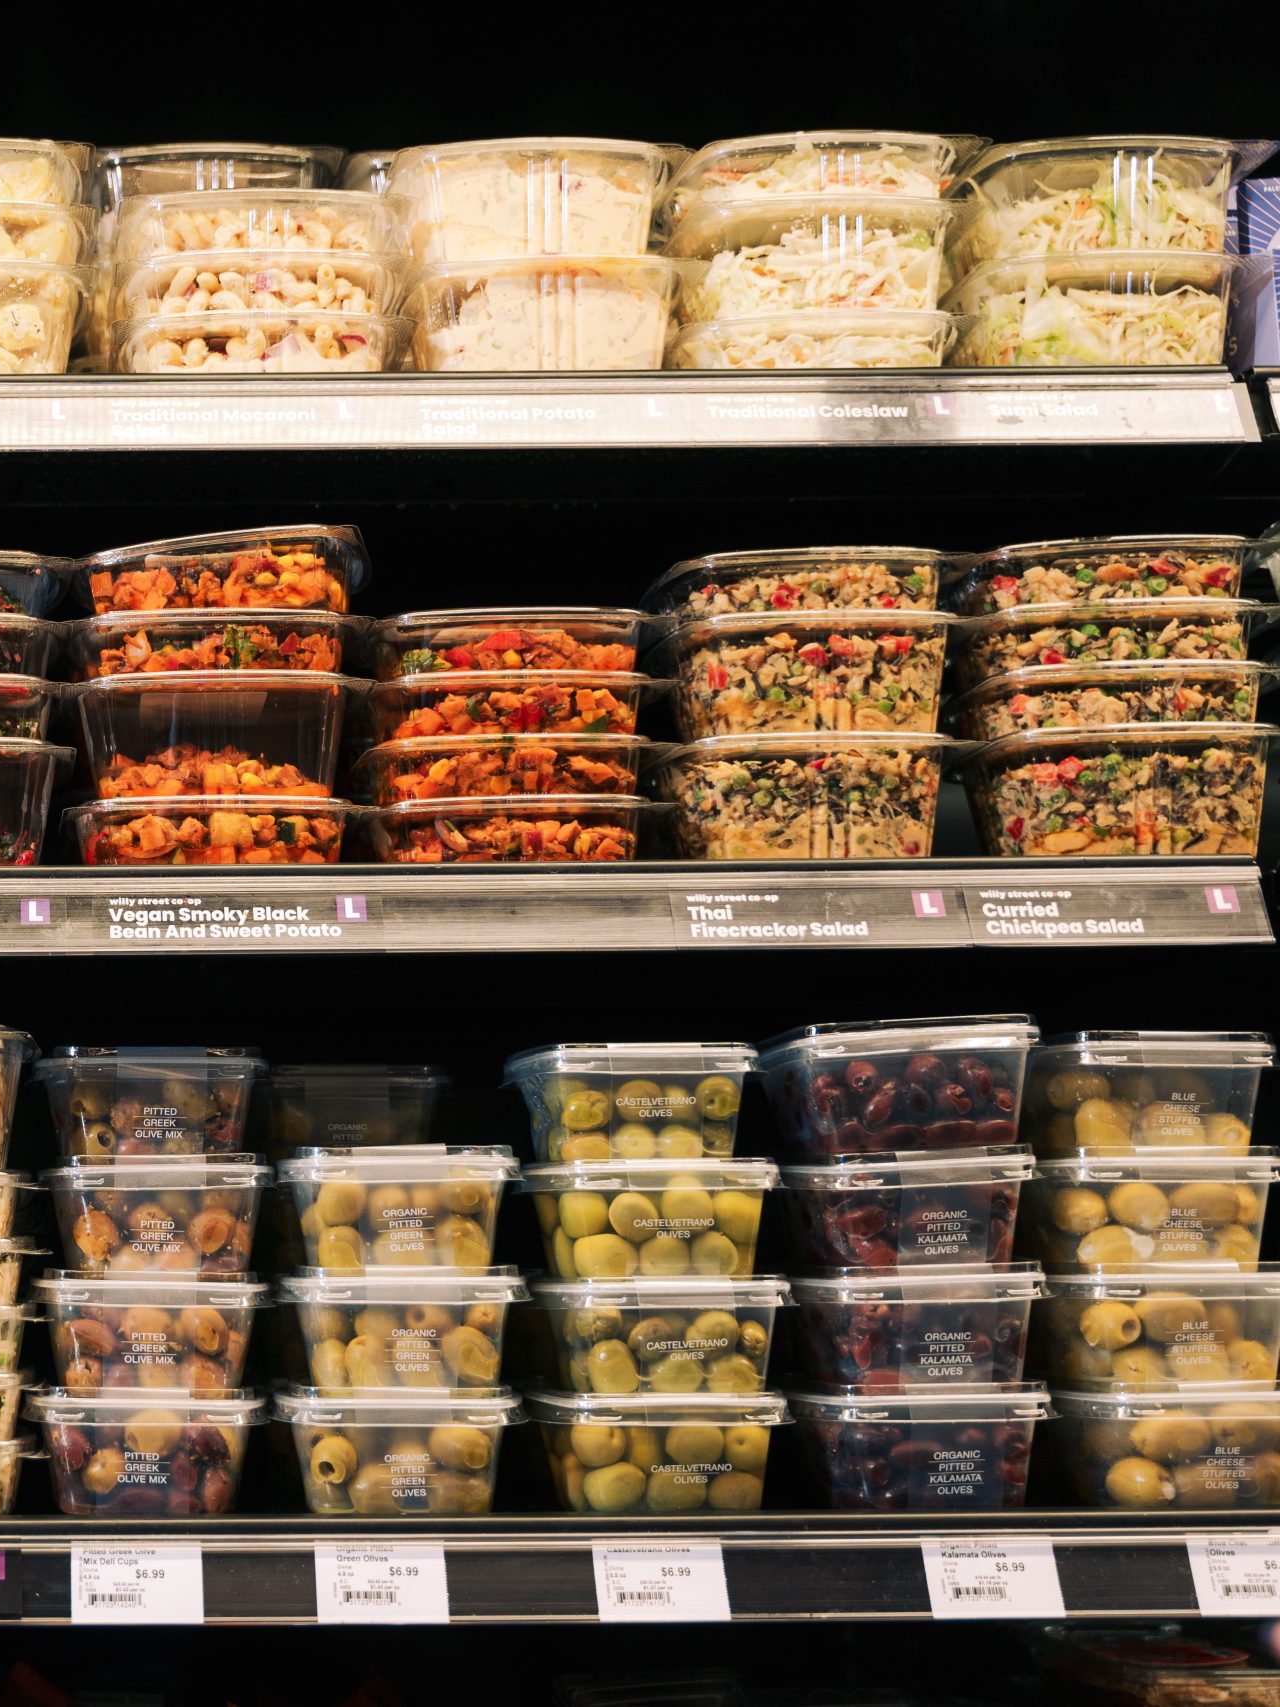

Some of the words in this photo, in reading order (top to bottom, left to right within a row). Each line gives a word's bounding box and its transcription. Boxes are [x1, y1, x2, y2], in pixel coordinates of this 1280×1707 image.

[420, 408, 528, 420] Traditional
[532, 408, 596, 420] Potato
[706, 405, 816, 418] Traditional
[820, 405, 908, 418] Coleslaw
[989, 404, 1038, 416] Sumi
[1043, 404, 1098, 416] Salad
[111, 409, 218, 422] Traditional
[223, 409, 316, 422] Macaroni
[687, 904, 732, 920] Thai
[982, 902, 1059, 917] Curried
[109, 908, 174, 925] Vegan
[179, 907, 248, 925] Smoky
[253, 906, 309, 920] Black
[110, 924, 160, 938] Bean
[165, 924, 205, 938] And
[210, 924, 271, 938] Sweet
[275, 924, 342, 938] Potato
[690, 922, 807, 938] Firecracker
[810, 921, 868, 936] Salad
[986, 920, 1083, 938] Chickpea
[1086, 918, 1144, 934] Salad
[616, 1096, 696, 1106] CASTELVETRANO
[1172, 1093, 1197, 1102] BLUE
[144, 1108, 177, 1116] PITTED
[1164, 1104, 1201, 1113] CHEESE
[639, 1109, 672, 1118] OLIVES
[144, 1118, 176, 1127] GREEK
[1159, 1116, 1200, 1125] STUFFED
[135, 1130, 162, 1138] OLIVE
[166, 1130, 183, 1139] MIX
[1162, 1128, 1194, 1136] OLIVES
[382, 1208, 428, 1218] ORGANIC
[922, 1210, 967, 1220] ORGANIC
[1172, 1208, 1197, 1216] BLUE
[140, 1220, 175, 1229] PITTED
[389, 1220, 422, 1228] PITTED
[634, 1218, 714, 1228] CASTELVETRANO
[927, 1222, 960, 1232] PITTED
[1164, 1220, 1202, 1228] CHEESE
[140, 1232, 174, 1241] GREEK
[390, 1231, 423, 1240] GREEN
[656, 1231, 690, 1239] OLIVES
[918, 1234, 968, 1244] KALAMATA
[1160, 1232, 1202, 1240] STUFFED
[132, 1243, 160, 1252] OLIVE
[162, 1244, 180, 1253] MIX
[390, 1242, 424, 1252] OLIVES
[925, 1246, 959, 1254] OLIVES
[1162, 1243, 1197, 1252] OLIVES
[1182, 1322, 1208, 1330] BLUE
[132, 1332, 166, 1341] PITTED
[392, 1328, 436, 1337] ORGANIC
[924, 1332, 972, 1341] ORGANIC
[1175, 1333, 1215, 1342] CHEESE
[132, 1344, 166, 1352] GREEK
[396, 1340, 430, 1348] PITTED
[646, 1338, 728, 1350] CASTELVETRANO
[930, 1344, 964, 1352] PITTED
[1172, 1344, 1216, 1354] STUFFED
[124, 1355, 152, 1364] OLIVE
[156, 1356, 174, 1364] MIX
[396, 1352, 429, 1360] GREEN
[670, 1352, 704, 1361] OLIVES
[920, 1356, 972, 1364] KALAMATA
[1176, 1356, 1212, 1365] OLIVES
[395, 1364, 429, 1372] OLIVES
[928, 1367, 963, 1376] OLIVES
[934, 1450, 981, 1460] ORGANIC
[1214, 1446, 1240, 1455] BLUE
[124, 1452, 160, 1460] PITTED
[384, 1454, 430, 1462] ORGANIC
[938, 1462, 974, 1471] PITTED
[1206, 1458, 1246, 1466] CHEESE
[125, 1464, 159, 1472] GREEK
[390, 1466, 424, 1474] PITTED
[650, 1464, 732, 1473] CASTELVETRANO
[1202, 1470, 1246, 1478] STUFFED
[118, 1474, 146, 1483] OLIVE
[149, 1476, 168, 1484] MIX
[392, 1477, 426, 1486] GREEN
[674, 1476, 708, 1484] OLIVES
[930, 1474, 982, 1484] KALAMATA
[1205, 1480, 1239, 1489] OLIVES
[392, 1488, 426, 1497] OLIVES
[937, 1486, 974, 1495] OLIVES
[118, 1558, 138, 1566] Cups
[389, 1566, 418, 1576] $6.99
[661, 1567, 690, 1576] $6.99
[995, 1562, 1025, 1572] $6.99
[136, 1569, 165, 1579] $6.99
